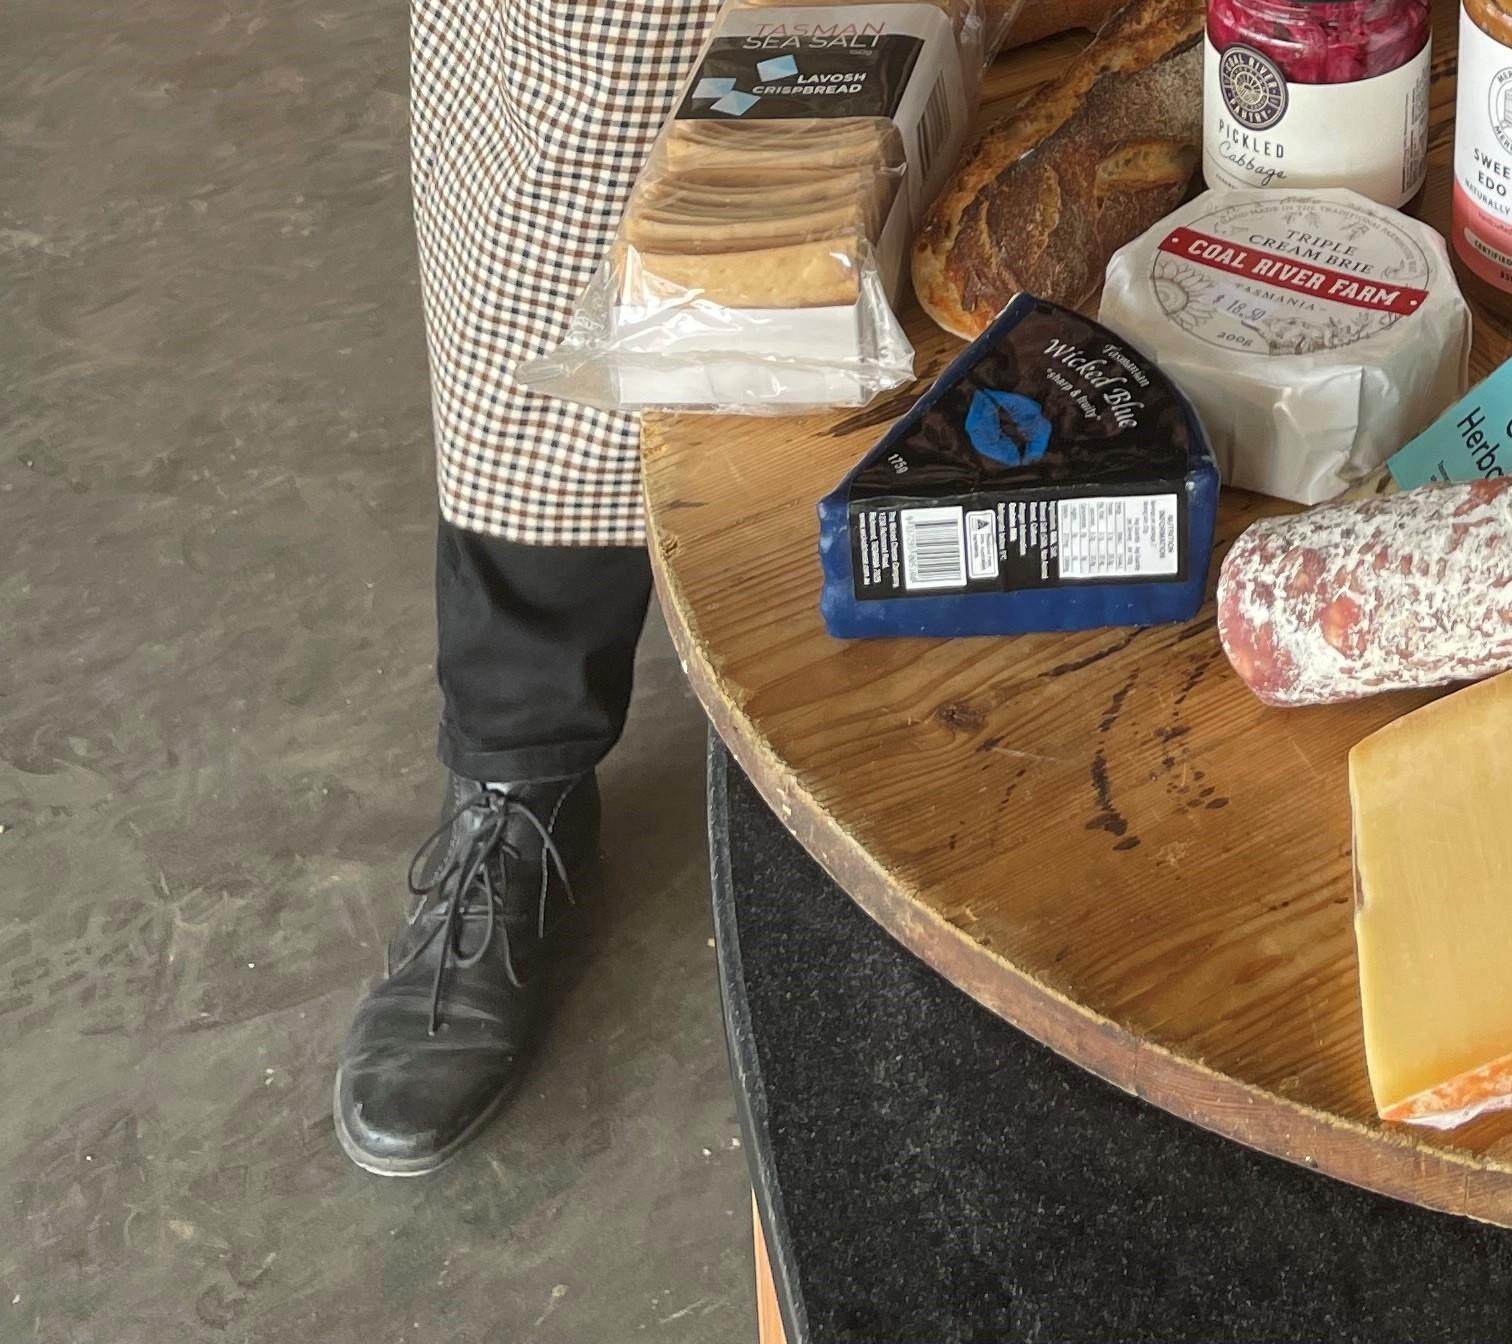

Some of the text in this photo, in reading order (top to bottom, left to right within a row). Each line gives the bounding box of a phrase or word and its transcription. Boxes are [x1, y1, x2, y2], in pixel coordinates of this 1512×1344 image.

[742, 34, 880, 50] SEA SALT
[754, 21, 886, 37] TASMAN
[751, 84, 864, 95] CRISPBREAD
[797, 72, 867, 84] LAVOSH
[1218, 119, 1285, 159] PICKLED
[1218, 140, 1287, 187] Cabbage
[1465, 180, 1511, 217] NATURALLY
[1478, 171, 1507, 197] EDO
[1247, 234, 1376, 276] CREAM BRIE
[1286, 228, 1358, 257] TRIPLE
[1474, 239, 1512, 267] CERTIFIED
[1187, 238, 1401, 306] COAL RIVER FARM
[1233, 282, 1318, 312] TASMANIA
[1043, 338, 1128, 388] Wicked
[1103, 387, 1145, 428] Blue
